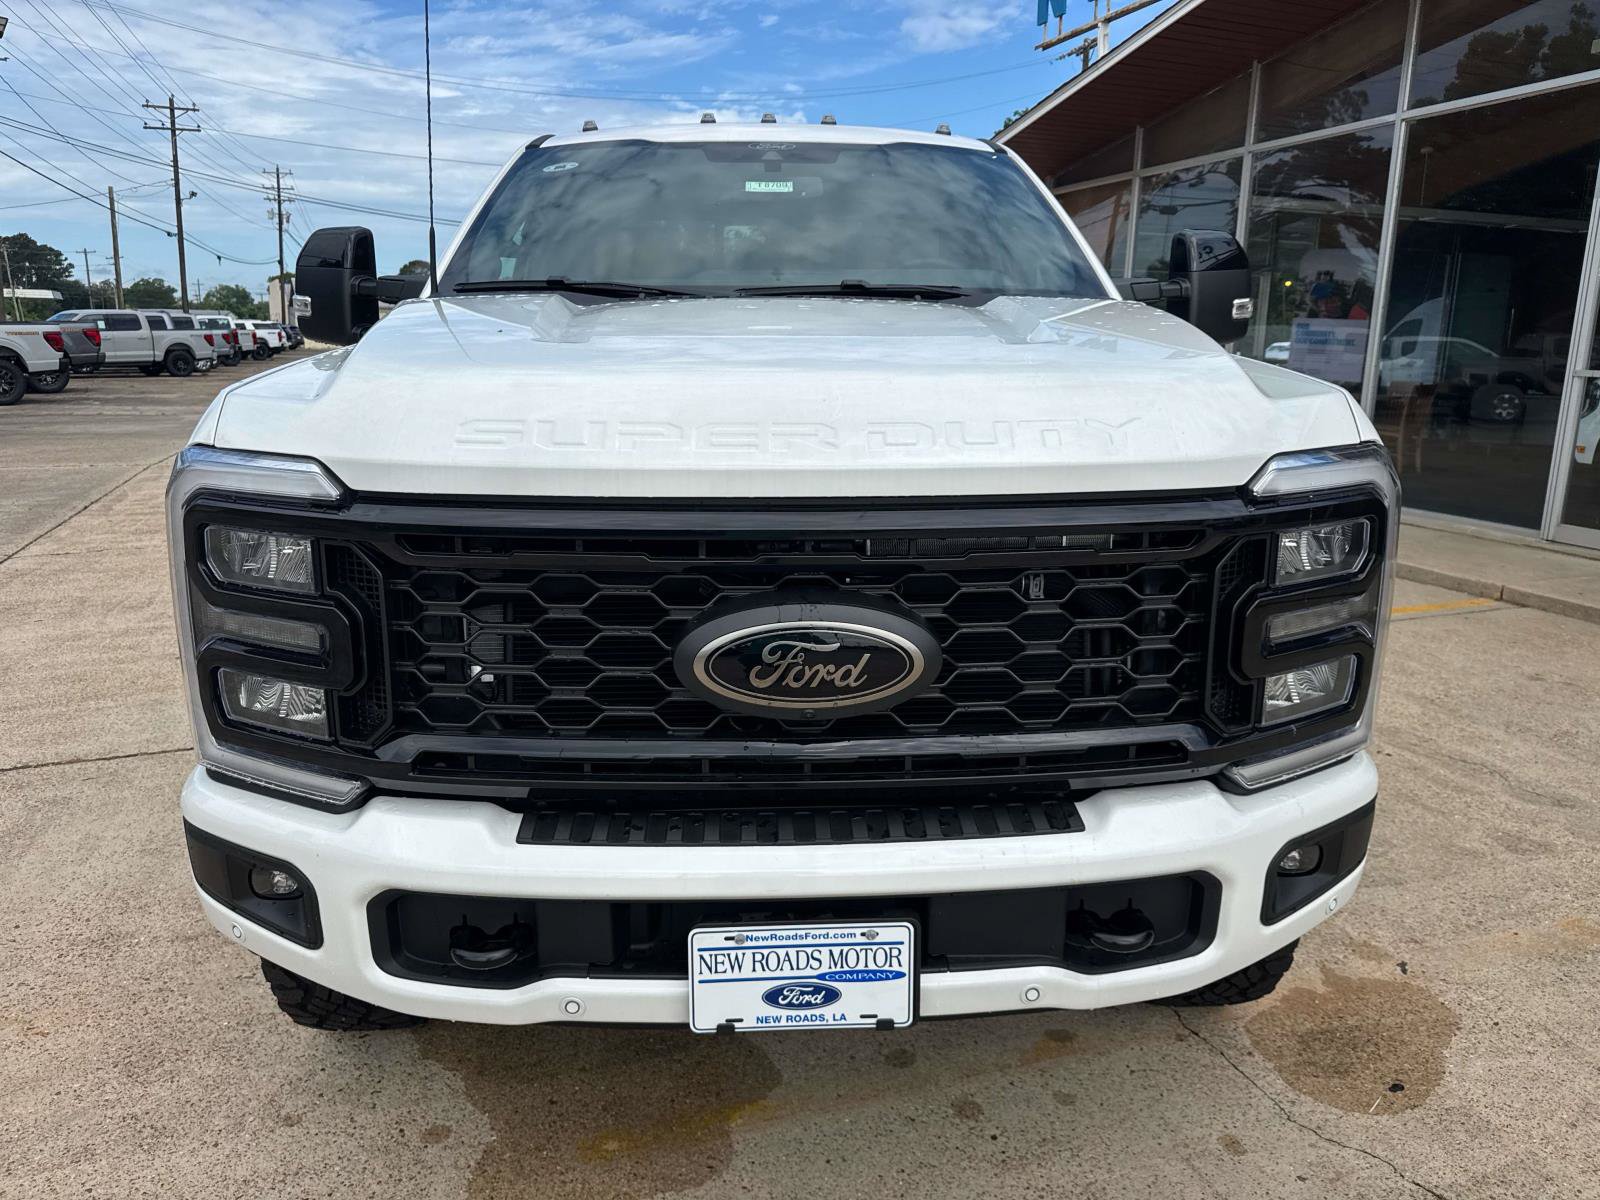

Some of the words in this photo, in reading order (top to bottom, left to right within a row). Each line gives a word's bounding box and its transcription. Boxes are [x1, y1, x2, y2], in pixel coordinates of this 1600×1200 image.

[455, 419, 841, 452] SUPER
[866, 417, 1142, 450] DUTY
[749, 640, 871, 688] Ford
[745, 931, 857, 943] NewRoadsFord.com
[698, 953, 746, 975] NEW
[751, 949, 823, 973] ROADS
[828, 947, 903, 970] MOTOR
[825, 971, 896, 981] COMPANY
[778, 986, 826, 1006] Ford
[756, 1014, 782, 1024] NEW
[785, 1013, 829, 1024] ROADS,
[832, 1012, 847, 1022] LA
